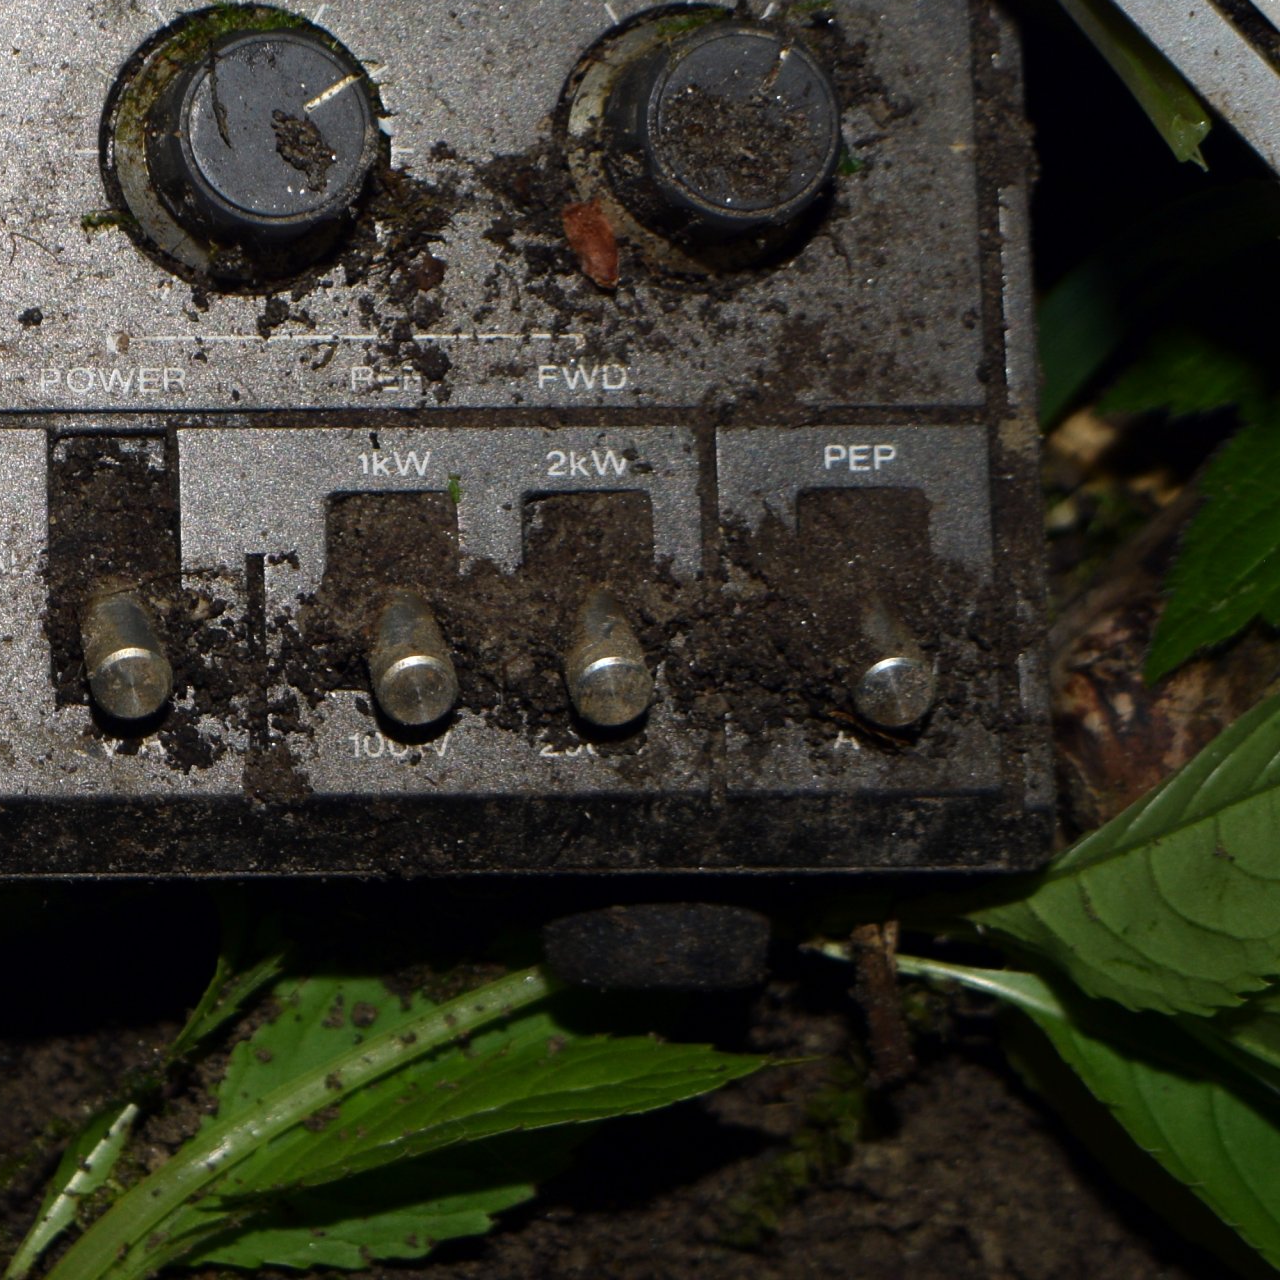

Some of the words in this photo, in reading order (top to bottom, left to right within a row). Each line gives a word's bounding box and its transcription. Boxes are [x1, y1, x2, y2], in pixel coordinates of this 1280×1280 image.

[40, 367, 187, 393] POWER
[538, 364, 628, 390] FWD
[358, 451, 431, 476] 1kW
[546, 450, 628, 476] 2kW
[824, 445, 896, 471] PEP
